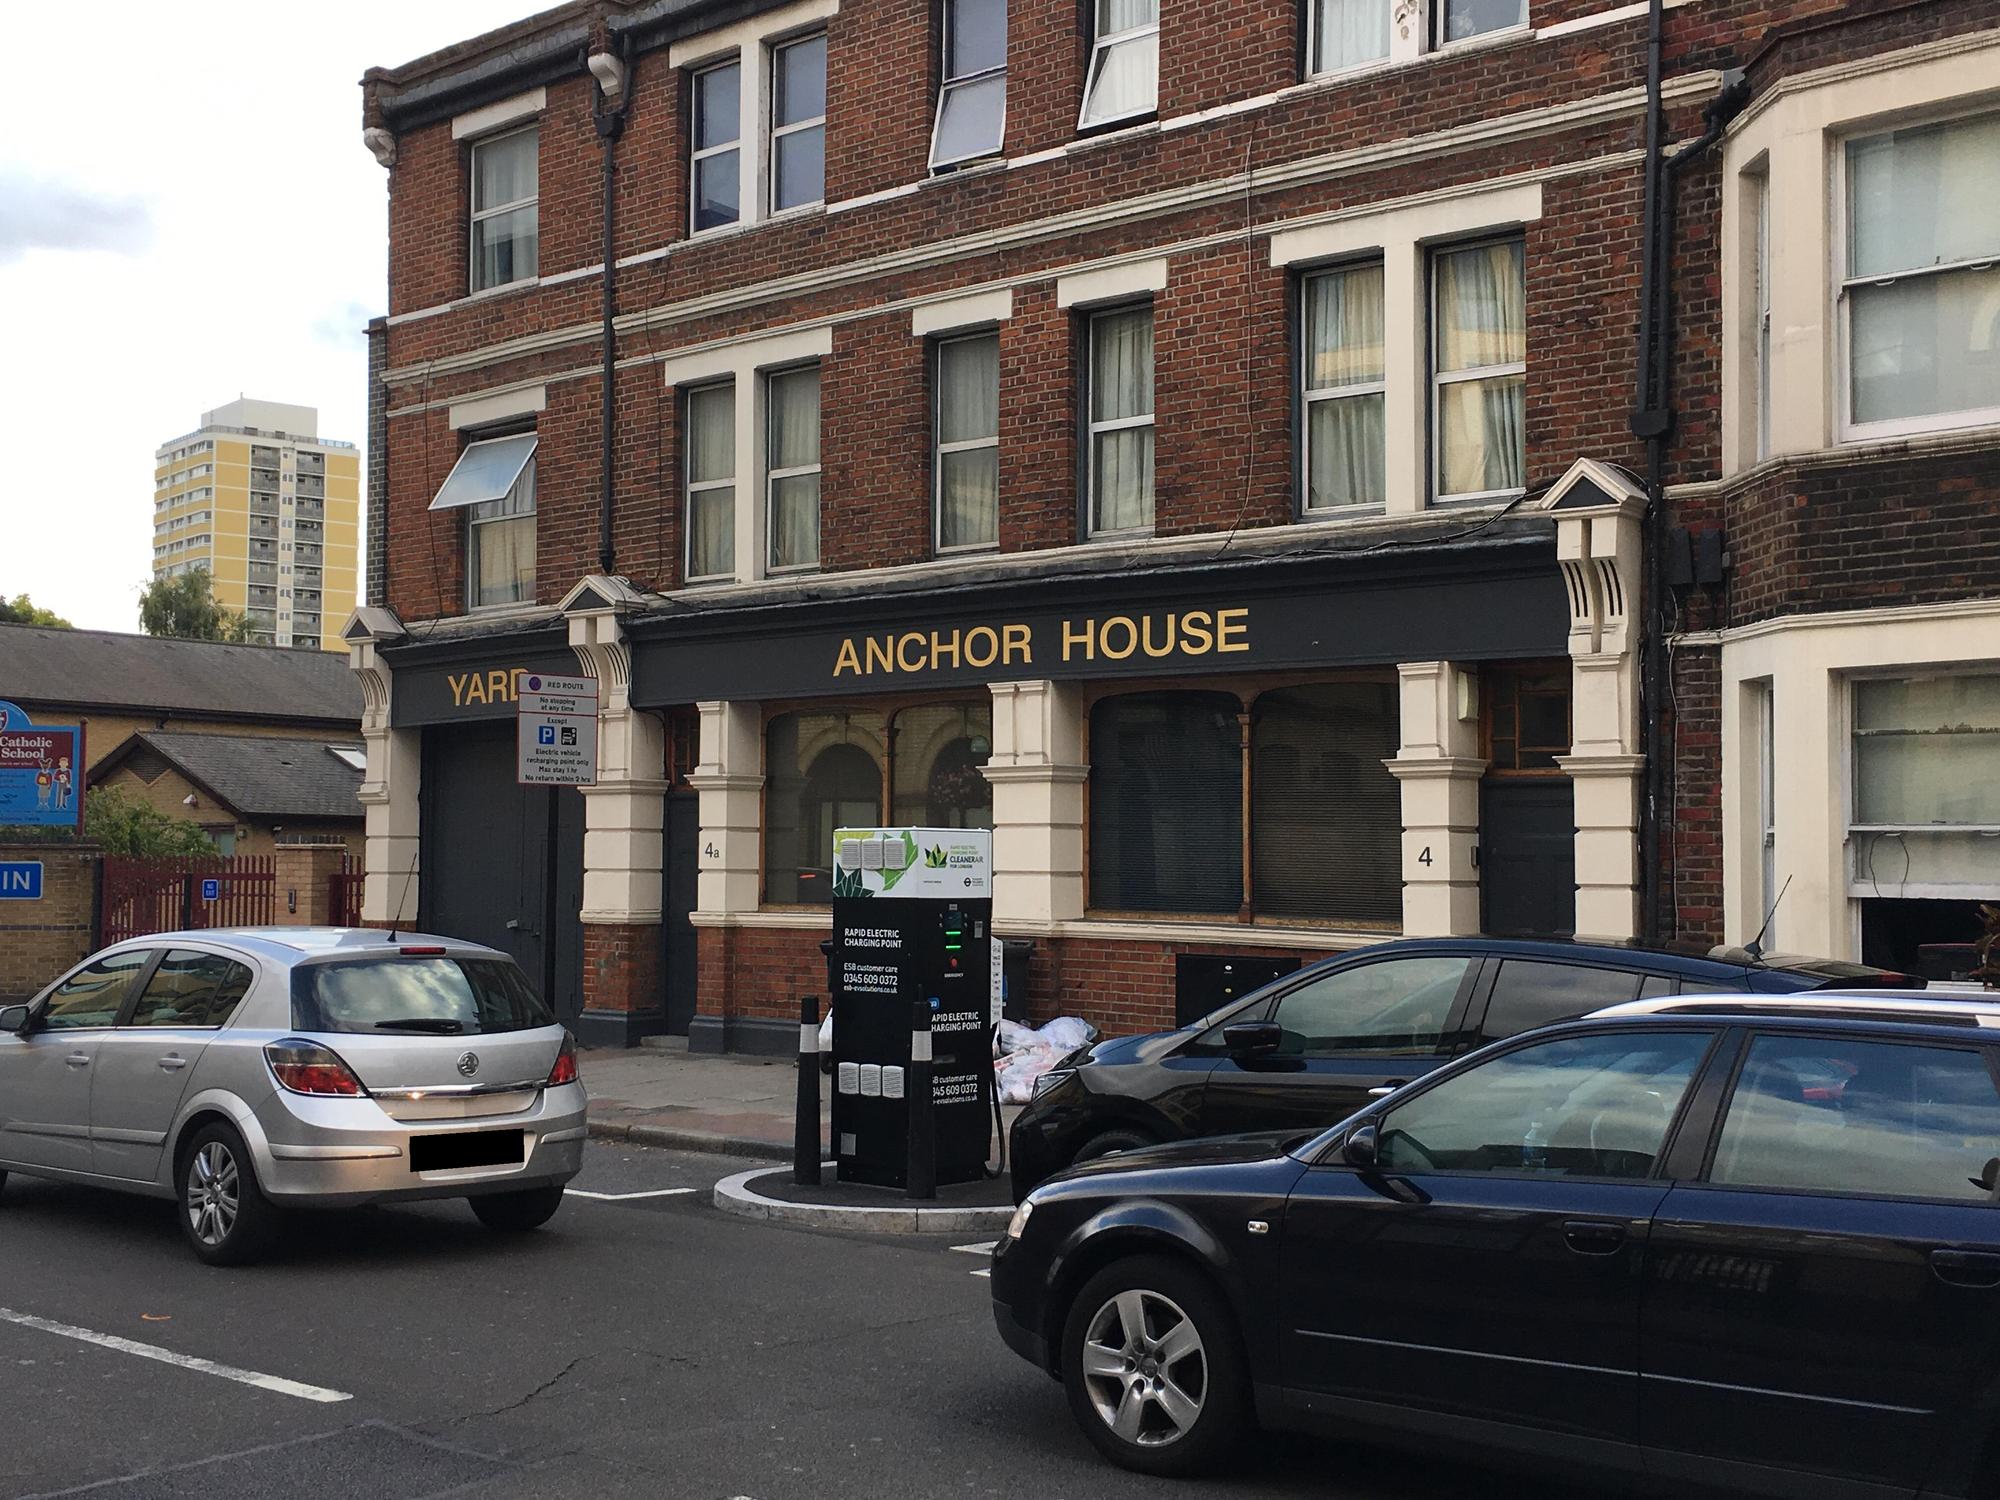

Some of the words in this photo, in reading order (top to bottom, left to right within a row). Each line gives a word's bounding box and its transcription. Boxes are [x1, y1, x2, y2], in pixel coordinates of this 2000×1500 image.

[832, 624, 1033, 677] ANCHOR
[1061, 608, 1250, 662] HOUSE
[547, 681, 561, 689] RED
[562, 682, 584, 690] ROUTE
[549, 697, 576, 706] stopping
[547, 717, 567, 725] Except
[543, 728, 553, 742] P
[0, 736, 53, 747] Catholic
[1, 748, 45, 758] School
[526, 757, 559, 766] recharging
[705, 842, 720, 858] 4a
[1418, 846, 1433, 867] 4
[2, 870, 31, 890] IN
[844, 928, 866, 938] RAPID
[866, 929, 900, 938] ELECTRIC
[844, 938, 881, 947] CHARGING
[881, 939, 902, 948] POINT
[843, 962, 856, 971] ESB
[857, 964, 885, 972] customer
[843, 973, 863, 983] 0345
[863, 974, 878, 984] 609
[879, 975, 898, 986] 0372
[931, 1012, 948, 1022] APID
[948, 1011, 979, 1021] ELECTRIC
[931, 1022, 961, 1033] HARGING
[962, 1021, 982, 1030] POINT
[939, 1075, 965, 1083] customer
[945, 1085, 960, 1095] 609
[961, 1084, 978, 1094] 0372
